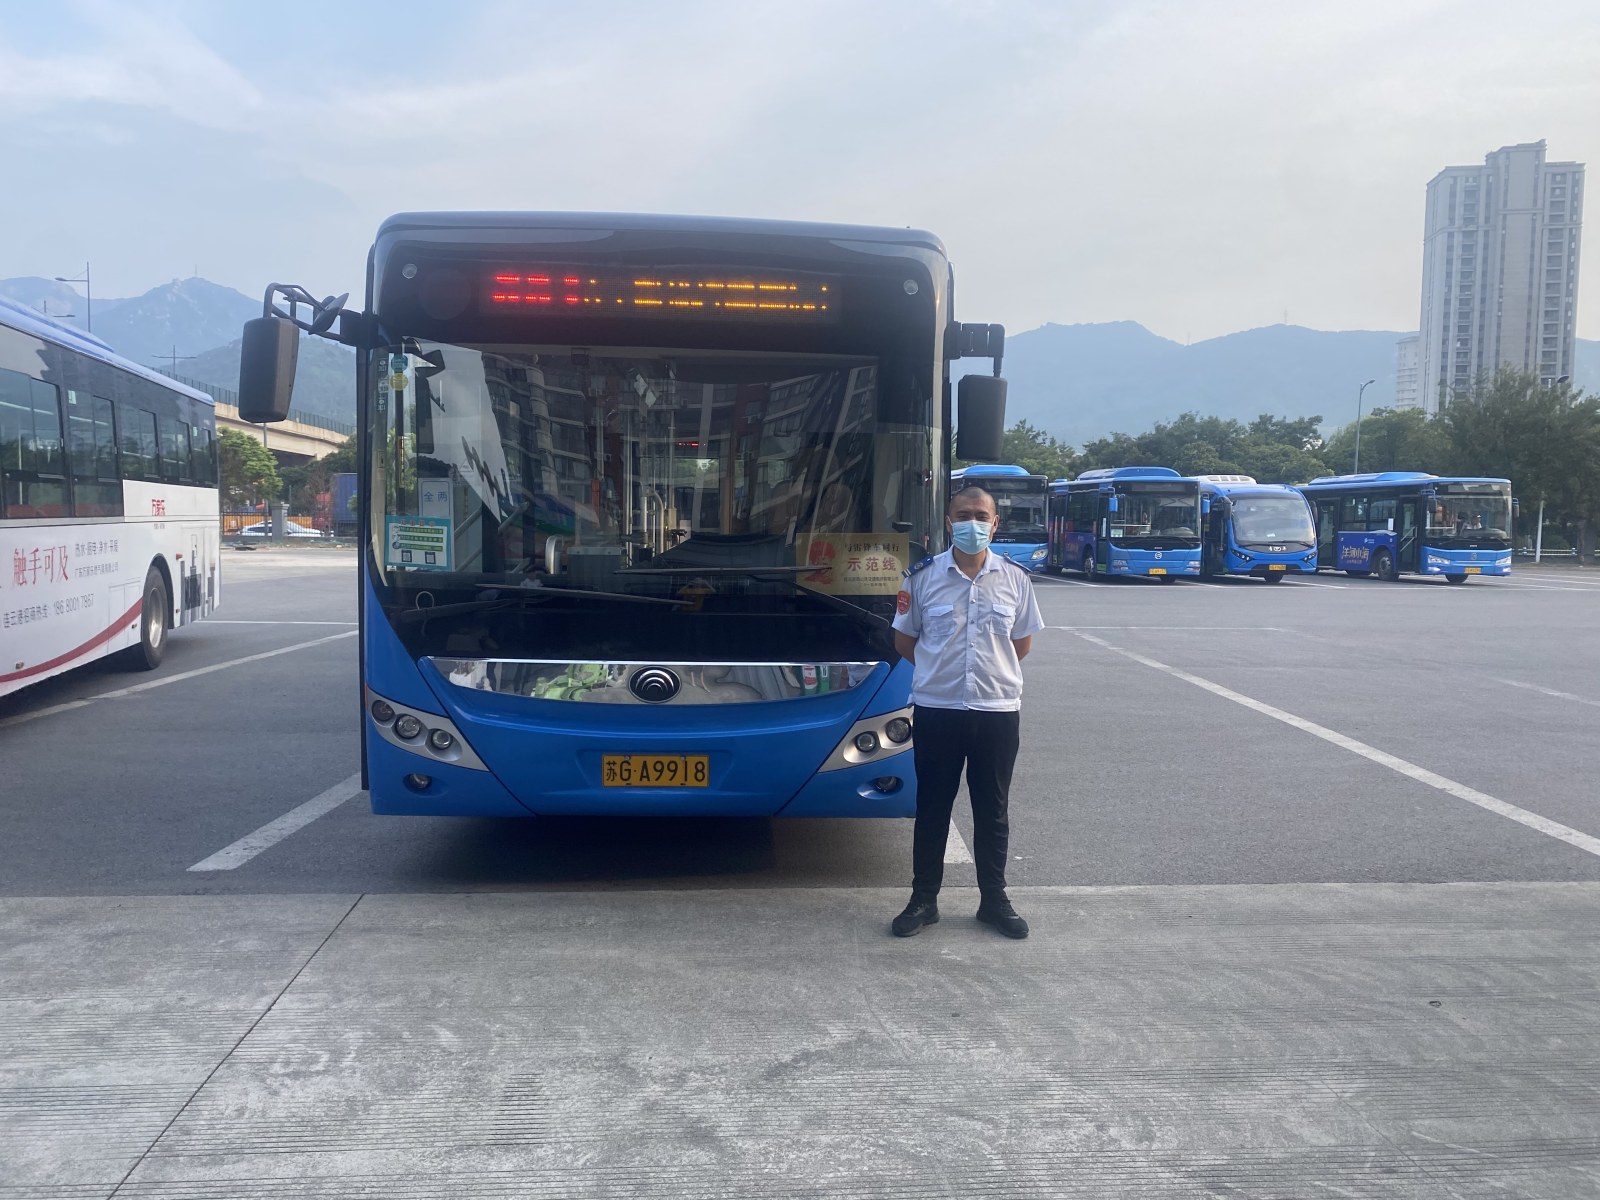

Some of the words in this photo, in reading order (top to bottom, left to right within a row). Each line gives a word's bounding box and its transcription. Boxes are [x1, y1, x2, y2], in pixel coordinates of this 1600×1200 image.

[151, 499, 165, 516] 万家乐
[12, 545, 69, 589] 触手可及
[847, 556, 897, 571] 示范线
[606, 760, 706, 783] 苏G·A9918
